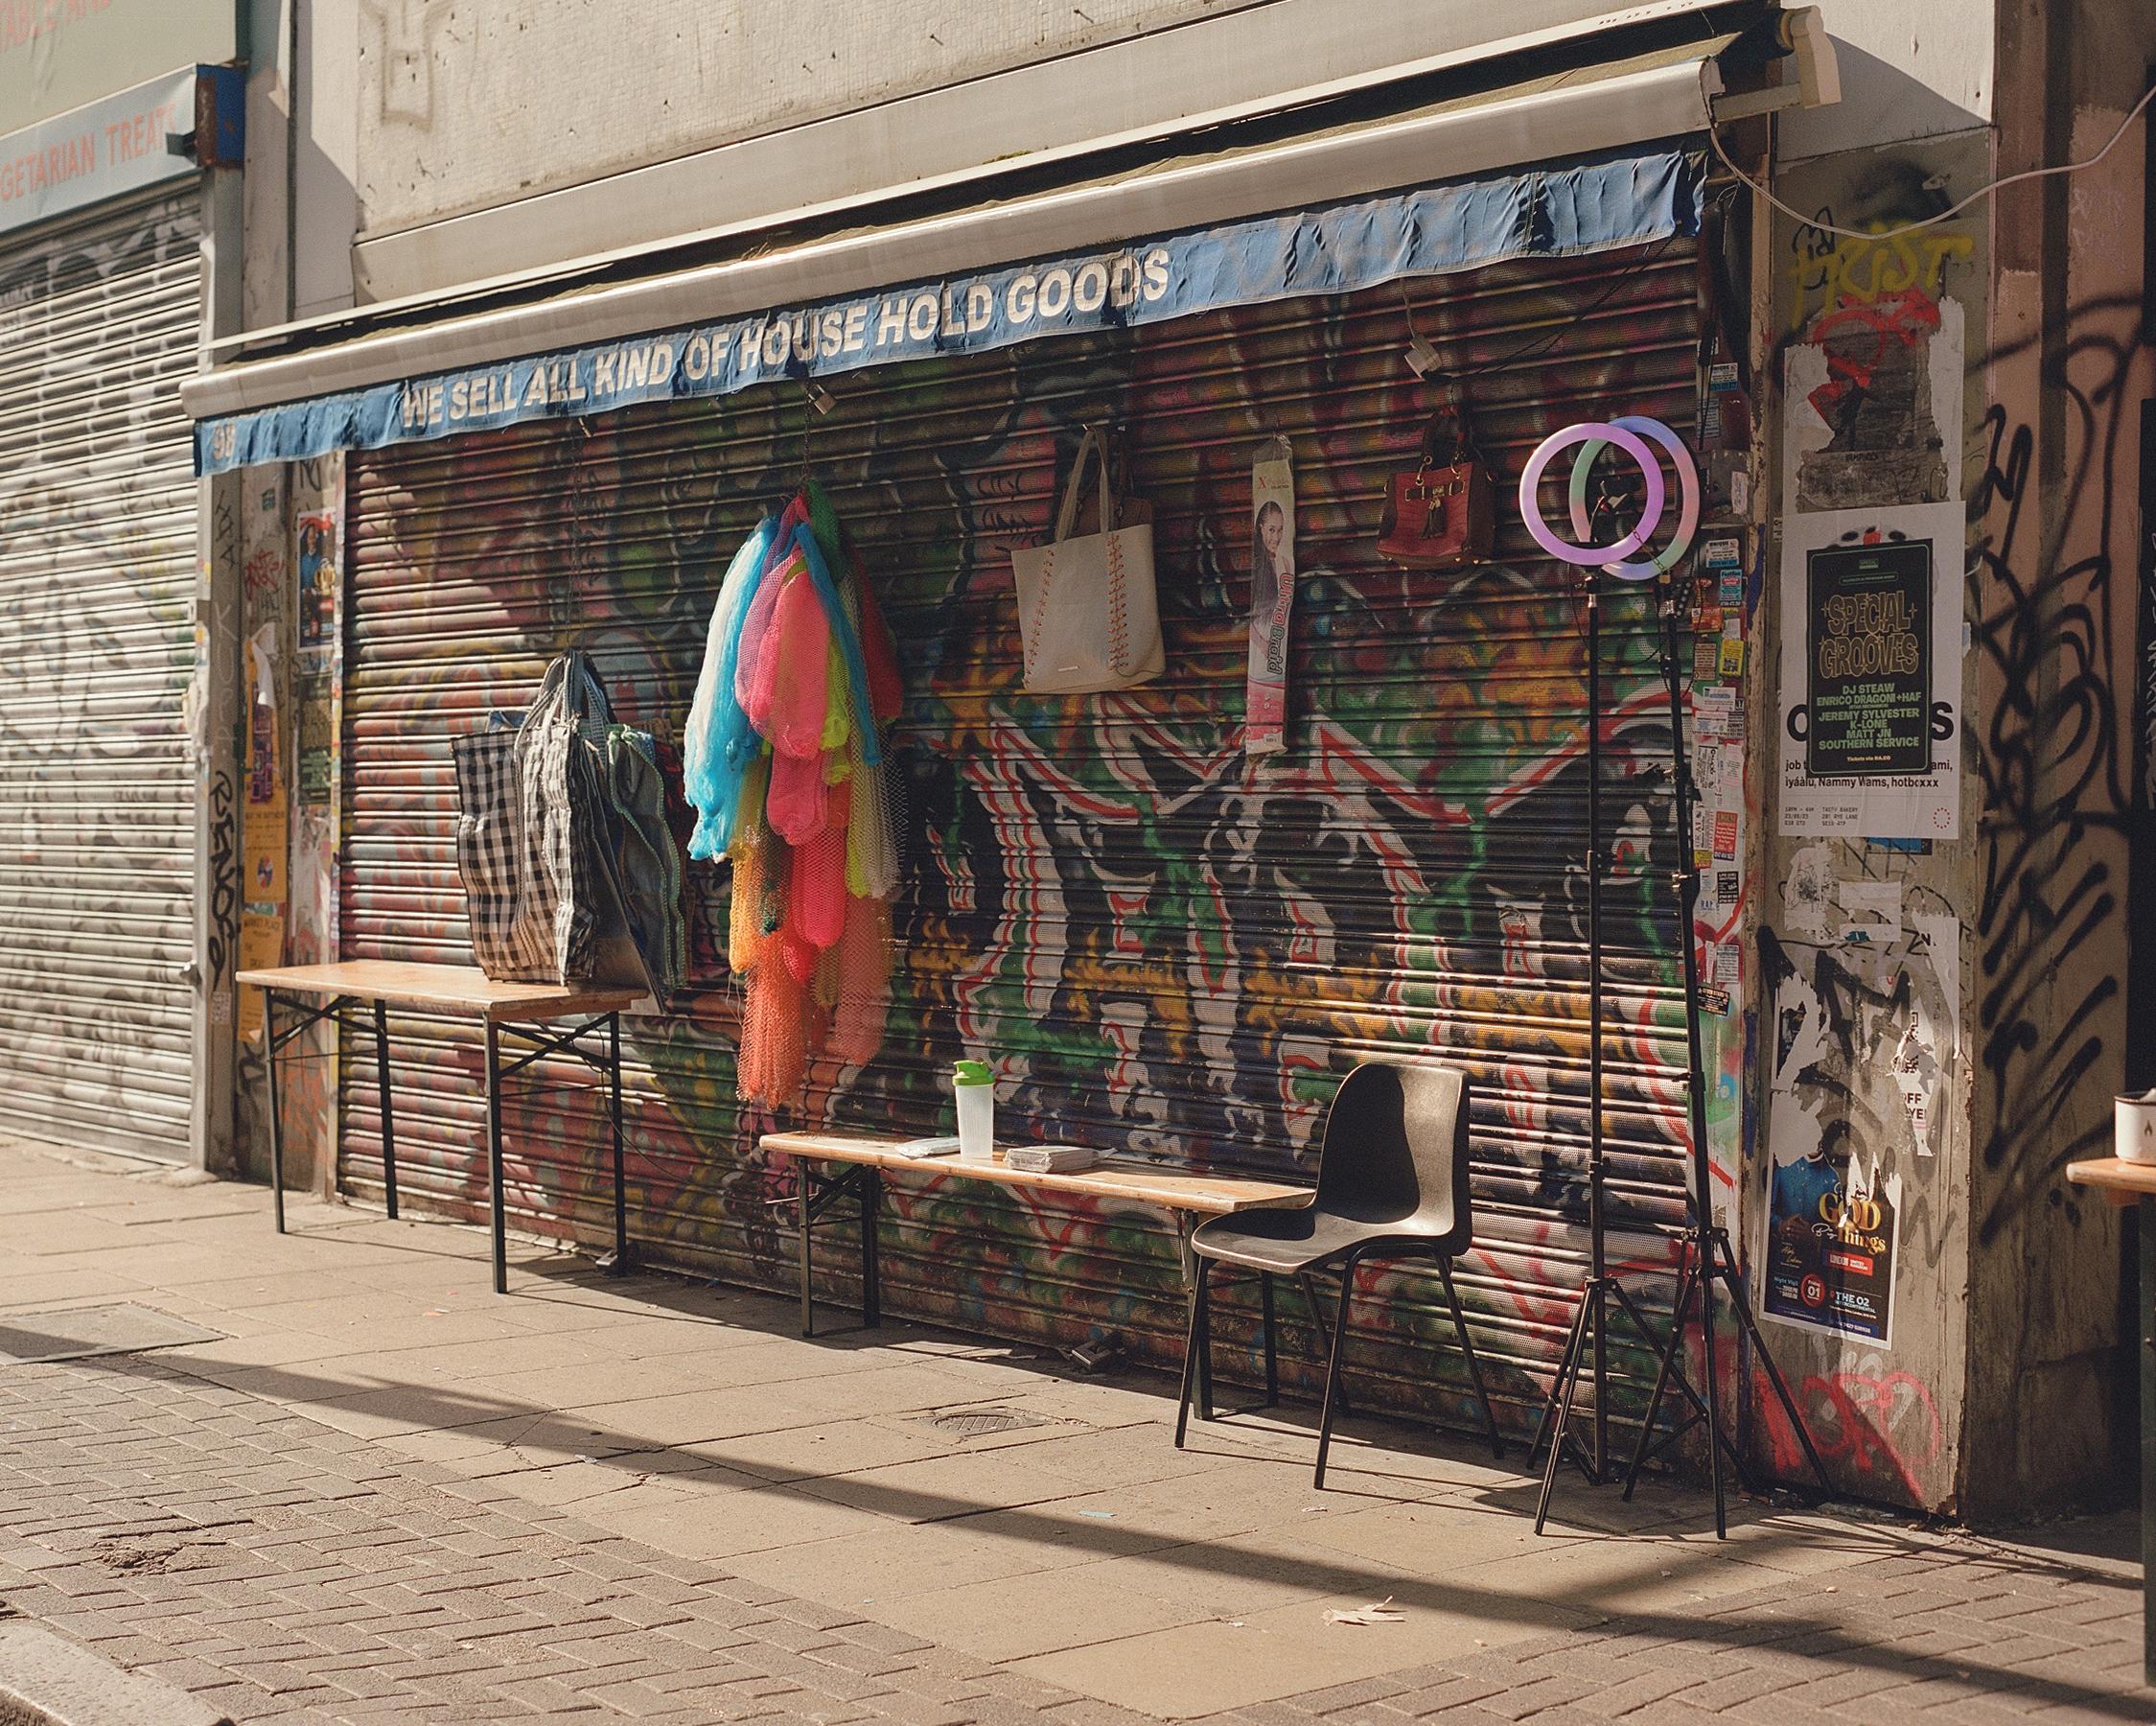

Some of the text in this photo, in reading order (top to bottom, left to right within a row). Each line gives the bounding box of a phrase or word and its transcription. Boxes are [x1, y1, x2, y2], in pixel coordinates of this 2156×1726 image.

[0, 131, 95, 199] GETARIAN
[213, 424, 236, 460] 98
[403, 385, 443, 429] WE
[451, 371, 519, 420] SELL
[526, 355, 586, 407] ALL
[594, 343, 673, 396] KIND
[684, 332, 729, 382] OF
[1007, 248, 1170, 324] GOODS
[1828, 591, 1911, 635] SPECIAL
[1266, 573, 1294, 675] Ultra Braid
[1820, 632, 1918, 679] GROOVES
[1843, 683, 1895, 694] DJ STEAW
[1817, 695, 1852, 707] ENRICO
[1854, 693, 1895, 705] DRAGONI
[1819, 708, 1920, 722] JEREMY SYLVESTER
[1850, 719, 1888, 729] K-LONE
[1846, 728, 1891, 739] MATT JN
[1819, 736, 1919, 751] SOUTHERN SERVICE
[1785, 759, 1801, 772] job
[1819, 778, 1857, 789] Nammy
[1807, 1286, 1820, 1298] 01
[1836, 1291, 1855, 1304] THE
